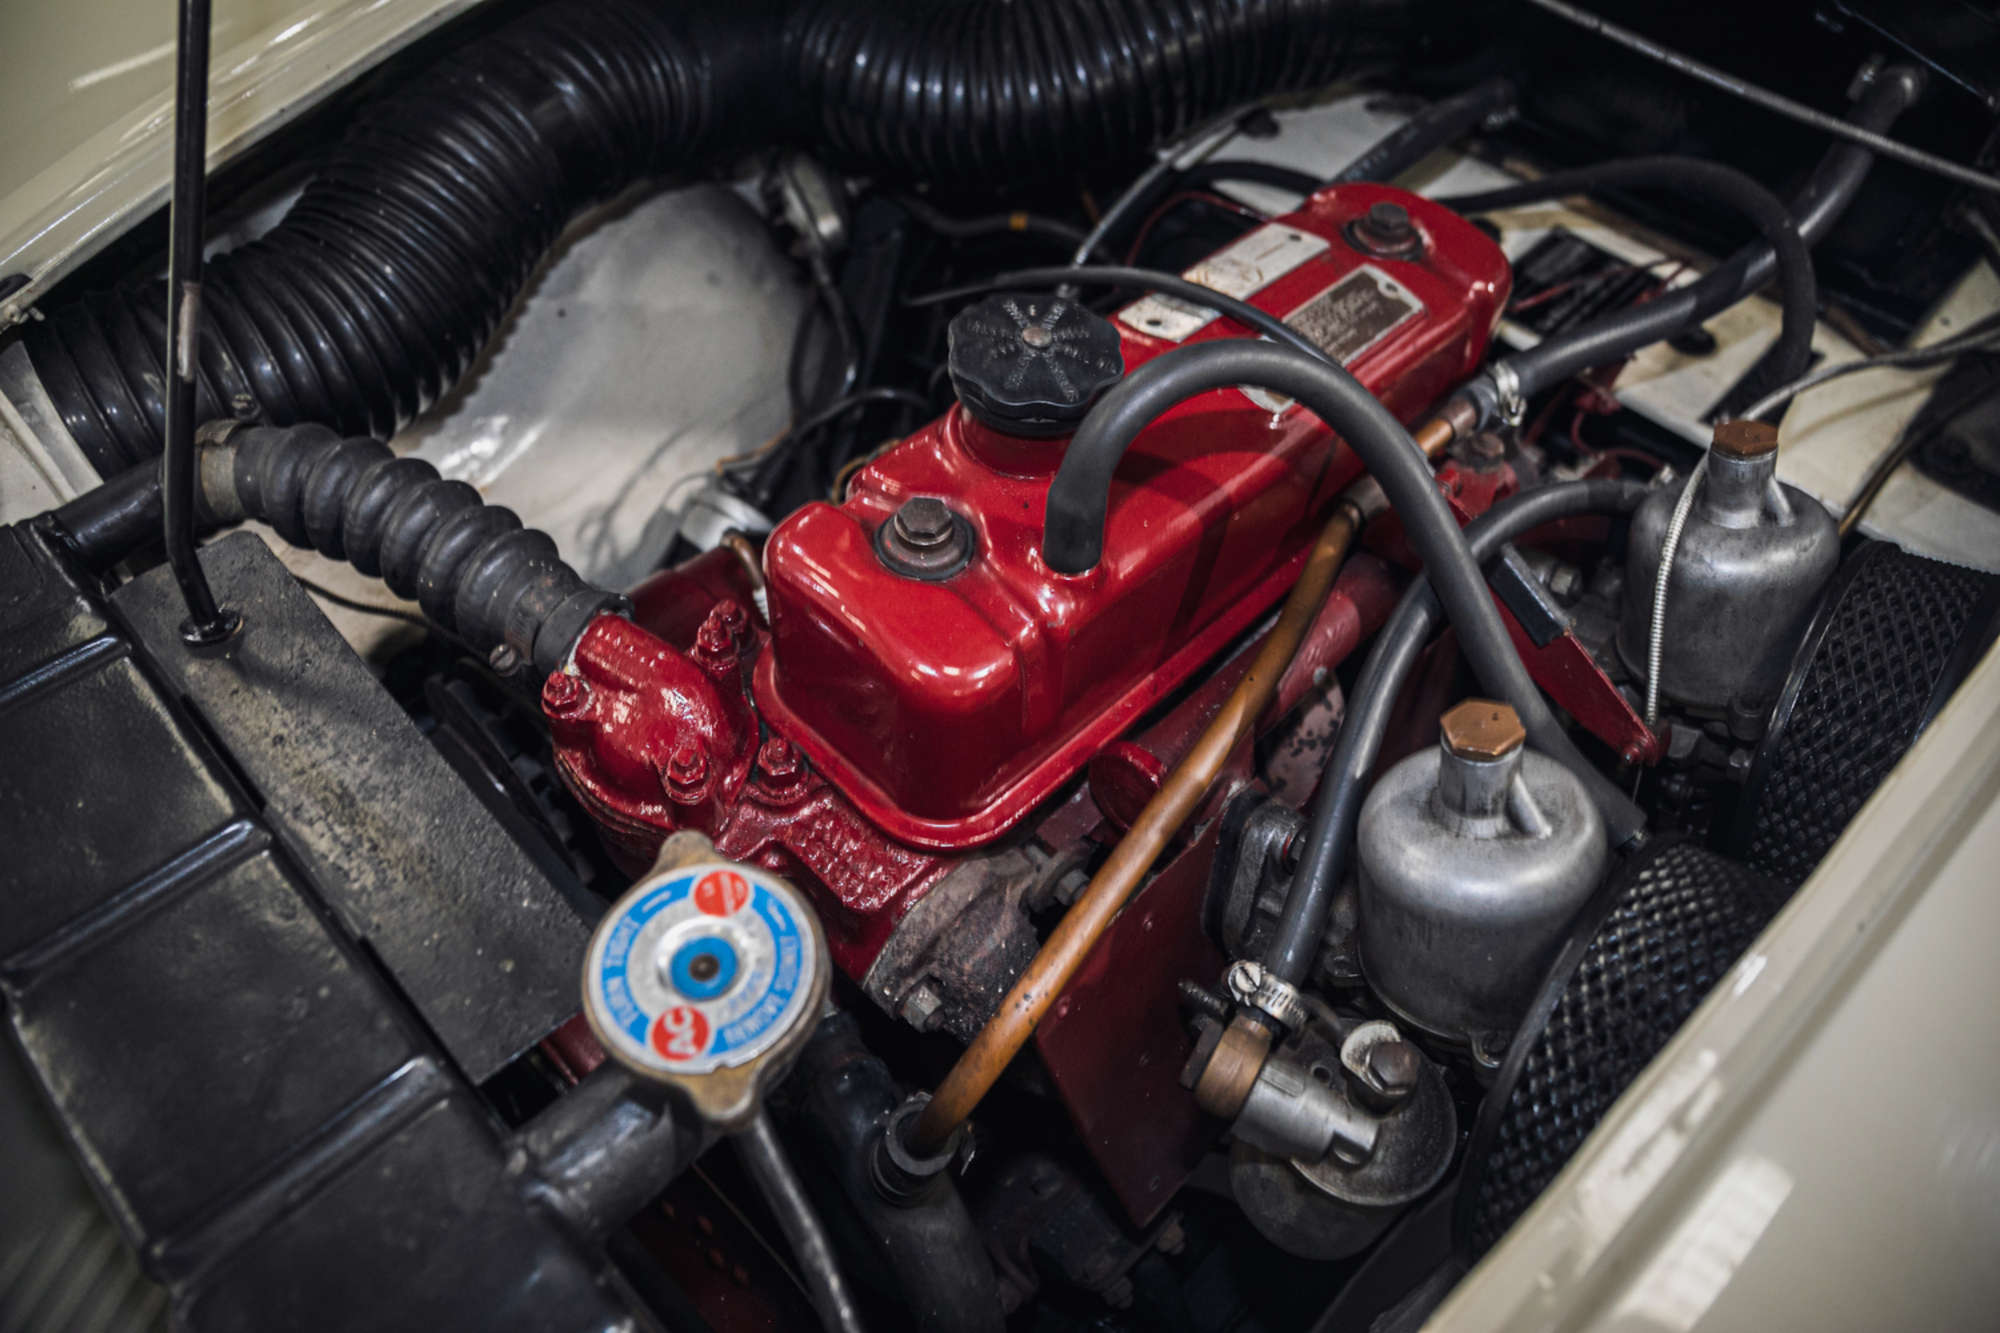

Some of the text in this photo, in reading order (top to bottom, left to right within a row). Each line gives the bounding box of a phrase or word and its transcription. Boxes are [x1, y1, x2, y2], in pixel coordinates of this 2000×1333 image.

[604, 915, 639, 1023] TURN TIGHT
[664, 1006, 698, 1055] AC
